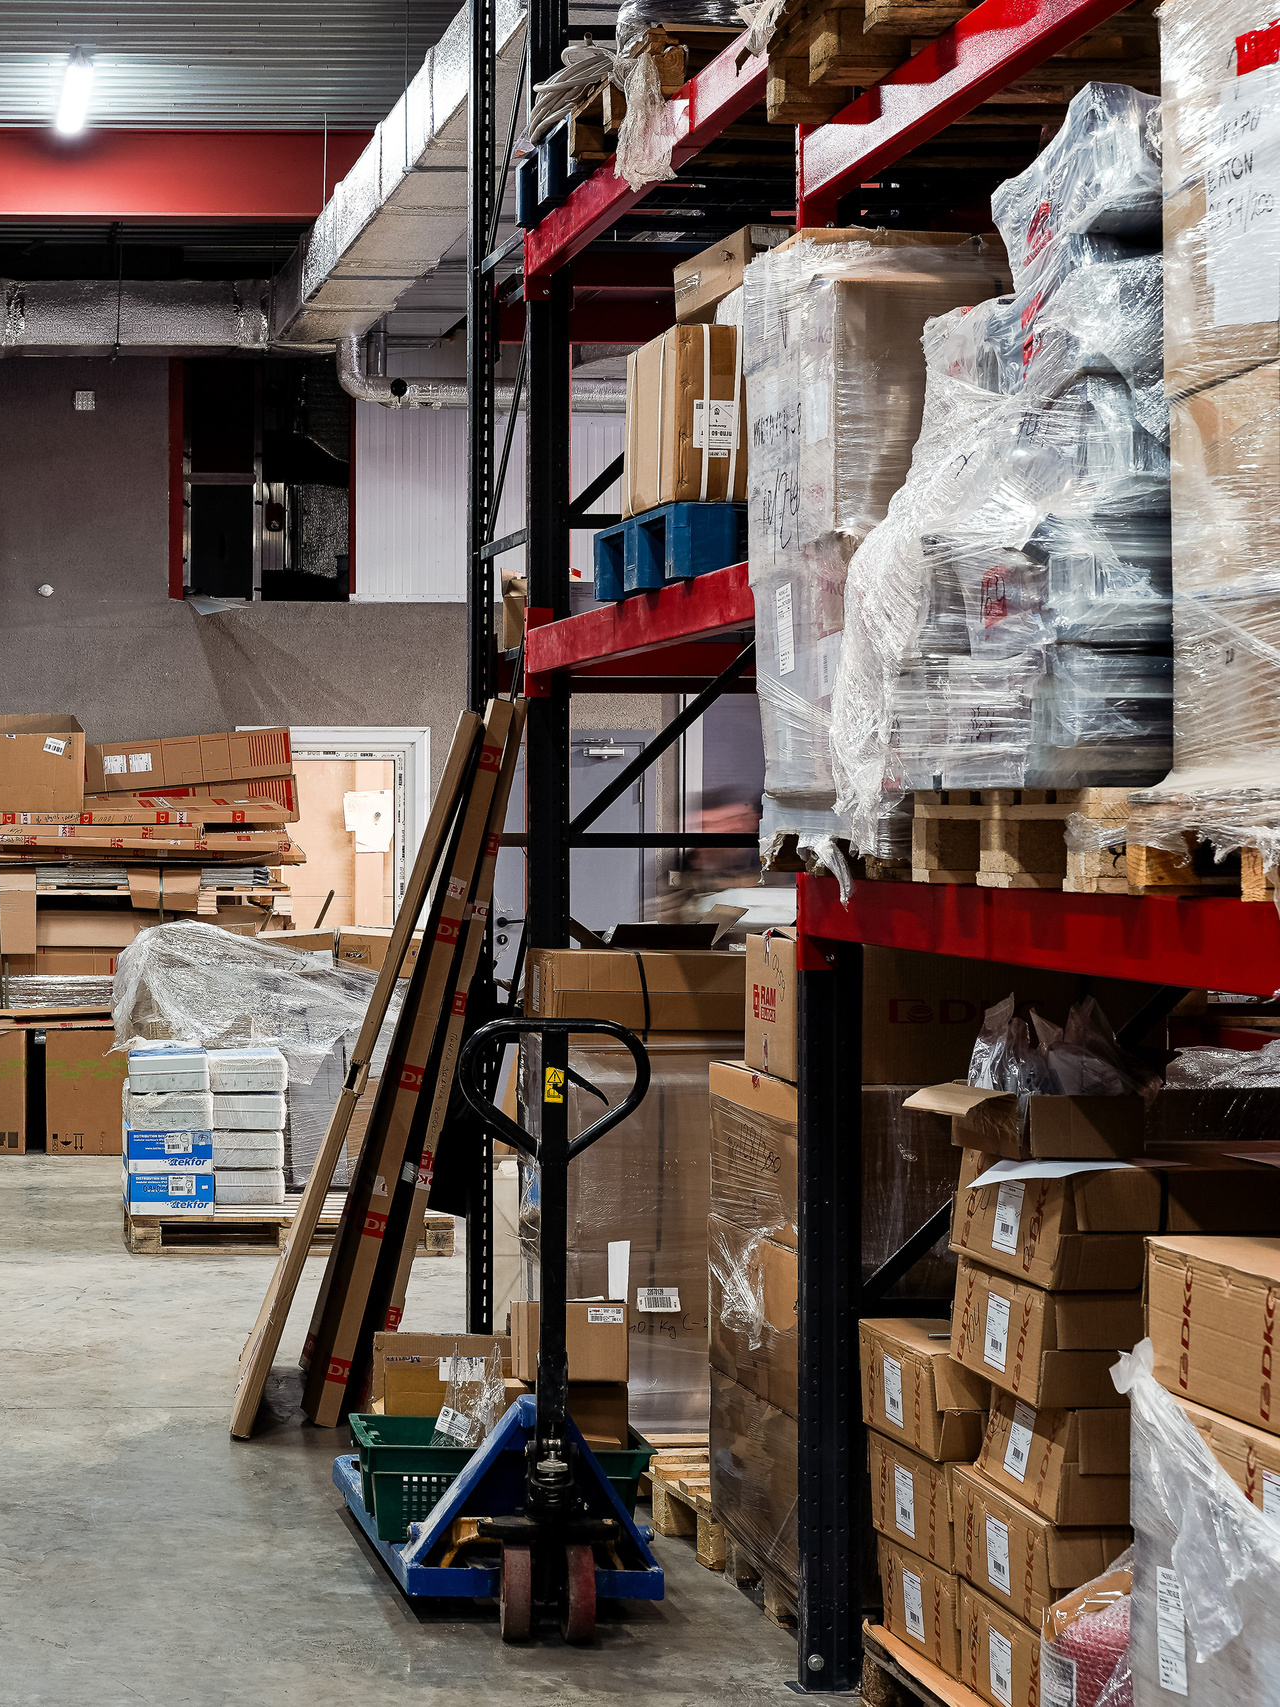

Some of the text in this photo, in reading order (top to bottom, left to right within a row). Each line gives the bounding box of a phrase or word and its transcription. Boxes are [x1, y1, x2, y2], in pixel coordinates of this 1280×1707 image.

[761, 985, 776, 1007] RAM
[761, 1008, 776, 1022] BLOCK
[172, 1158, 207, 1166] tekfor
[173, 1200, 209, 1209] tekfor
[1030, 1178, 1052, 1243] DKC
[962, 1266, 979, 1331] DKC
[1016, 1293, 1035, 1361] DKC
[1181, 1266, 1194, 1350] DKC
[1261, 1286, 1275, 1381] DKC
[929, 1472, 937, 1532] DKC
[1244, 1446, 1257, 1503] KC
[1024, 1528, 1037, 1598] DKC
[934, 1575, 942, 1640] DKC
[1027, 1643, 1042, 1707] DKC
